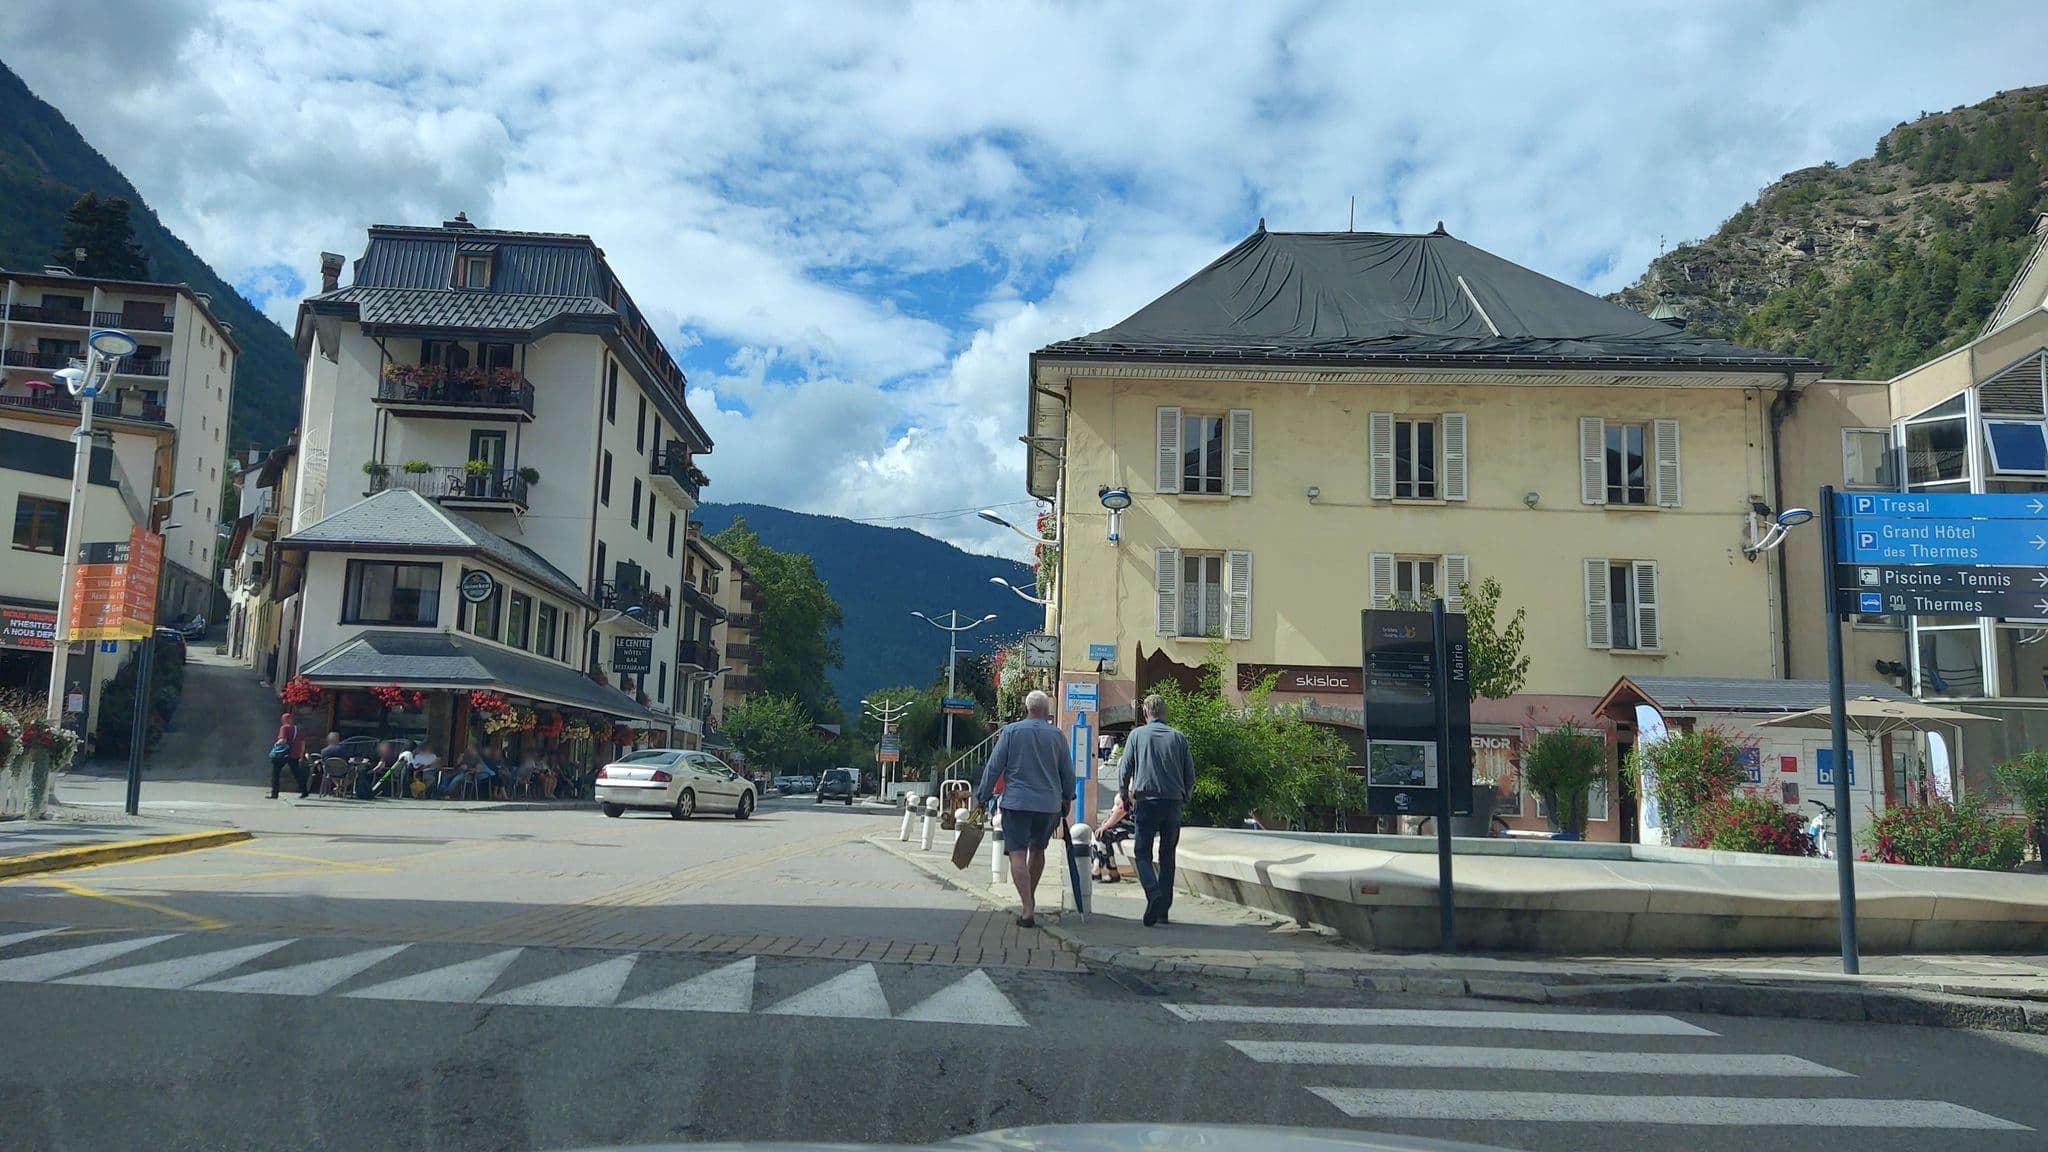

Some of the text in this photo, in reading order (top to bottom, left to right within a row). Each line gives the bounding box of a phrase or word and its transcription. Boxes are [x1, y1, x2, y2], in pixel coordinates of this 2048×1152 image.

[1880, 498, 1930, 512] Tresal
[1883, 525, 1929, 539] Grand
[1935, 525, 1976, 539] Hôtel
[1883, 544, 1978, 558] des Thermes
[1885, 570, 1942, 585] Piscine
[1957, 571, 2011, 587] Tennis
[1913, 596, 1983, 612] Thermes
[10, 618, 53, 630] N'HESITEZ
[11, 628, 35, 637] NOUS
[616, 639, 651, 648] LE CENTRE
[615, 664, 649, 672] RESTAURANT
[1452, 644, 1465, 681] Mairie
[1296, 674, 1349, 688] skisloc
